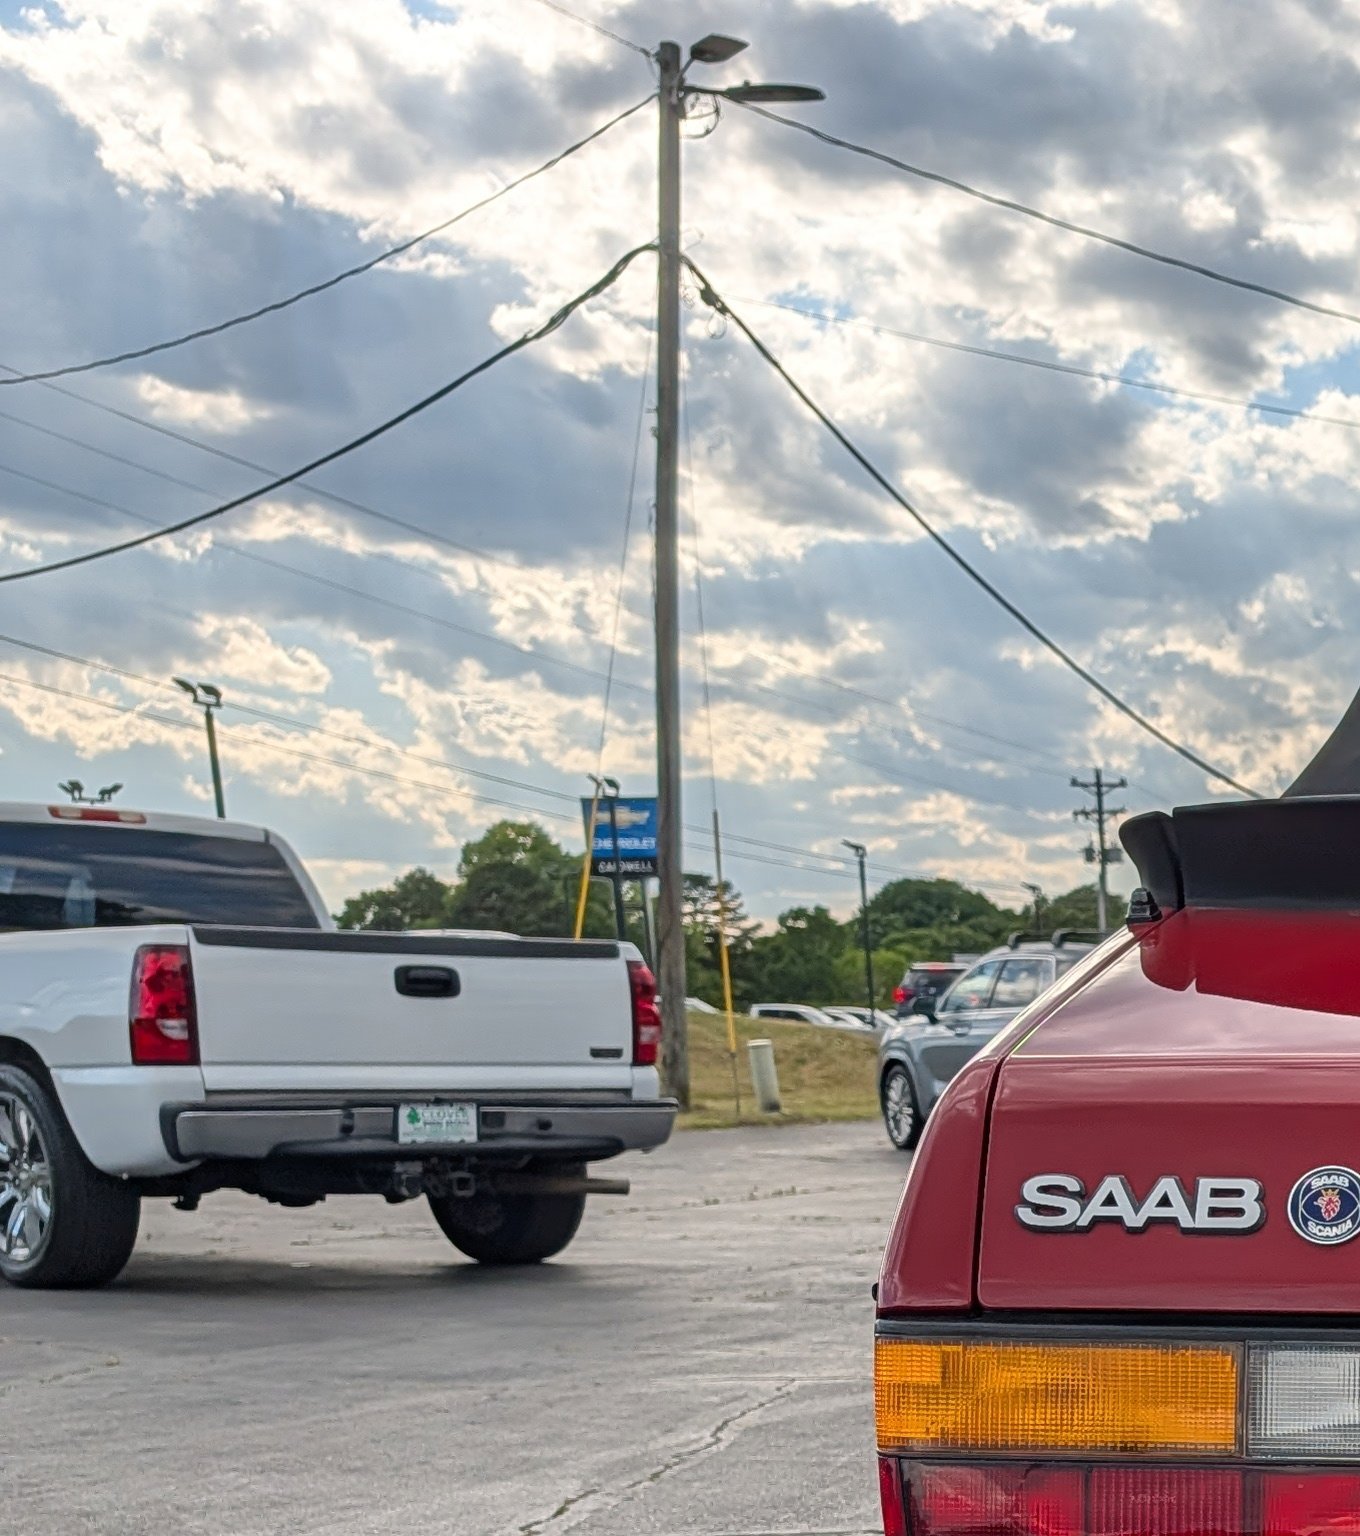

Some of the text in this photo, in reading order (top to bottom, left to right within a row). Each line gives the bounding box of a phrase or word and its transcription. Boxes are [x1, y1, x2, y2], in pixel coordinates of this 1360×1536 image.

[1311, 1175, 1350, 1189] SAAB
[1016, 1174, 1264, 1232] SAAB
[1308, 1219, 1352, 1237] SCANIA
